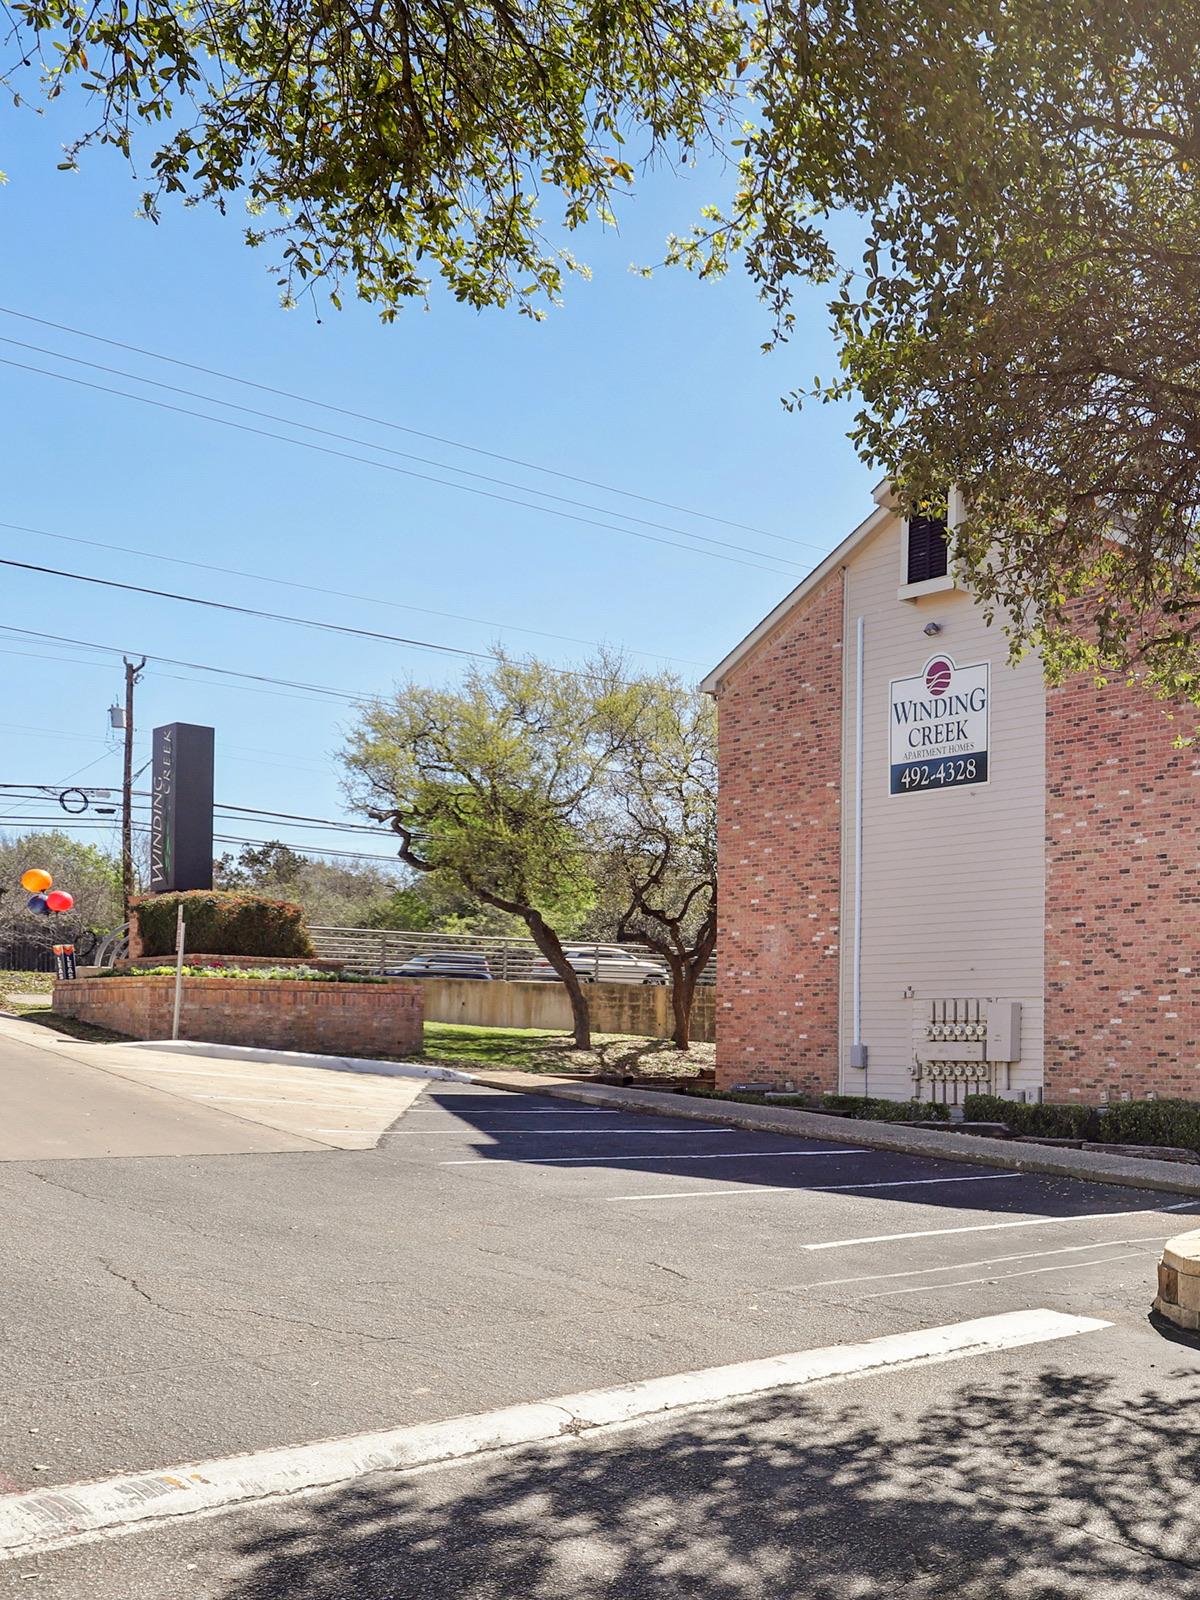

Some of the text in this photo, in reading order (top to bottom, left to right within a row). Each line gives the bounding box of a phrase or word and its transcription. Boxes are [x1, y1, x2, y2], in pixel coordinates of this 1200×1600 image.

[893, 687, 986, 725] WINDING
[903, 741, 975, 760] APARTMENT HOMES
[908, 719, 969, 748] CREEK
[162, 729, 172, 795] CREEK
[901, 758, 977, 789] 492-4328
[152, 776, 163, 883] WINDING
